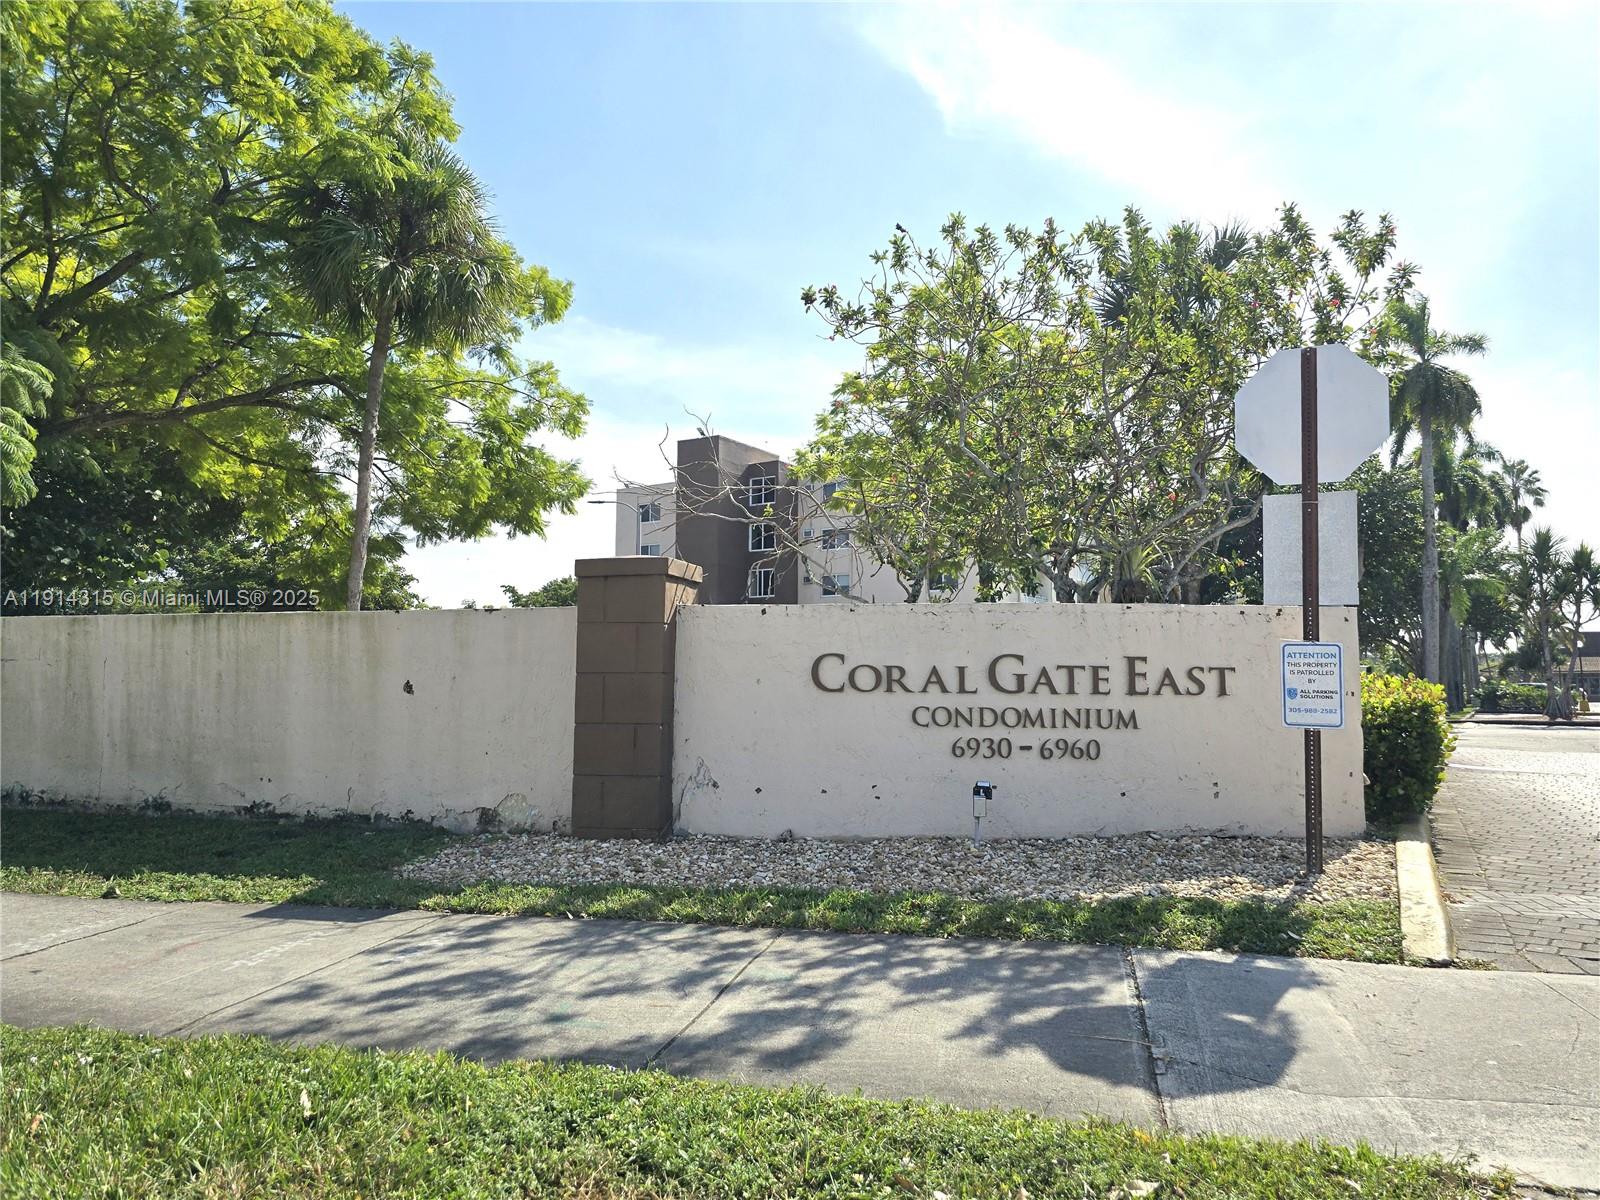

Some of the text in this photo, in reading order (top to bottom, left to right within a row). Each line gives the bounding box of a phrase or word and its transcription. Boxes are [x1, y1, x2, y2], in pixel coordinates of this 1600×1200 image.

[811, 652, 1237, 698] CORAL GATE EAST
[911, 706, 1141, 730] CONDOMINIUM
[951, 737, 1013, 759] 6930
[1039, 738, 1101, 761] 6960
